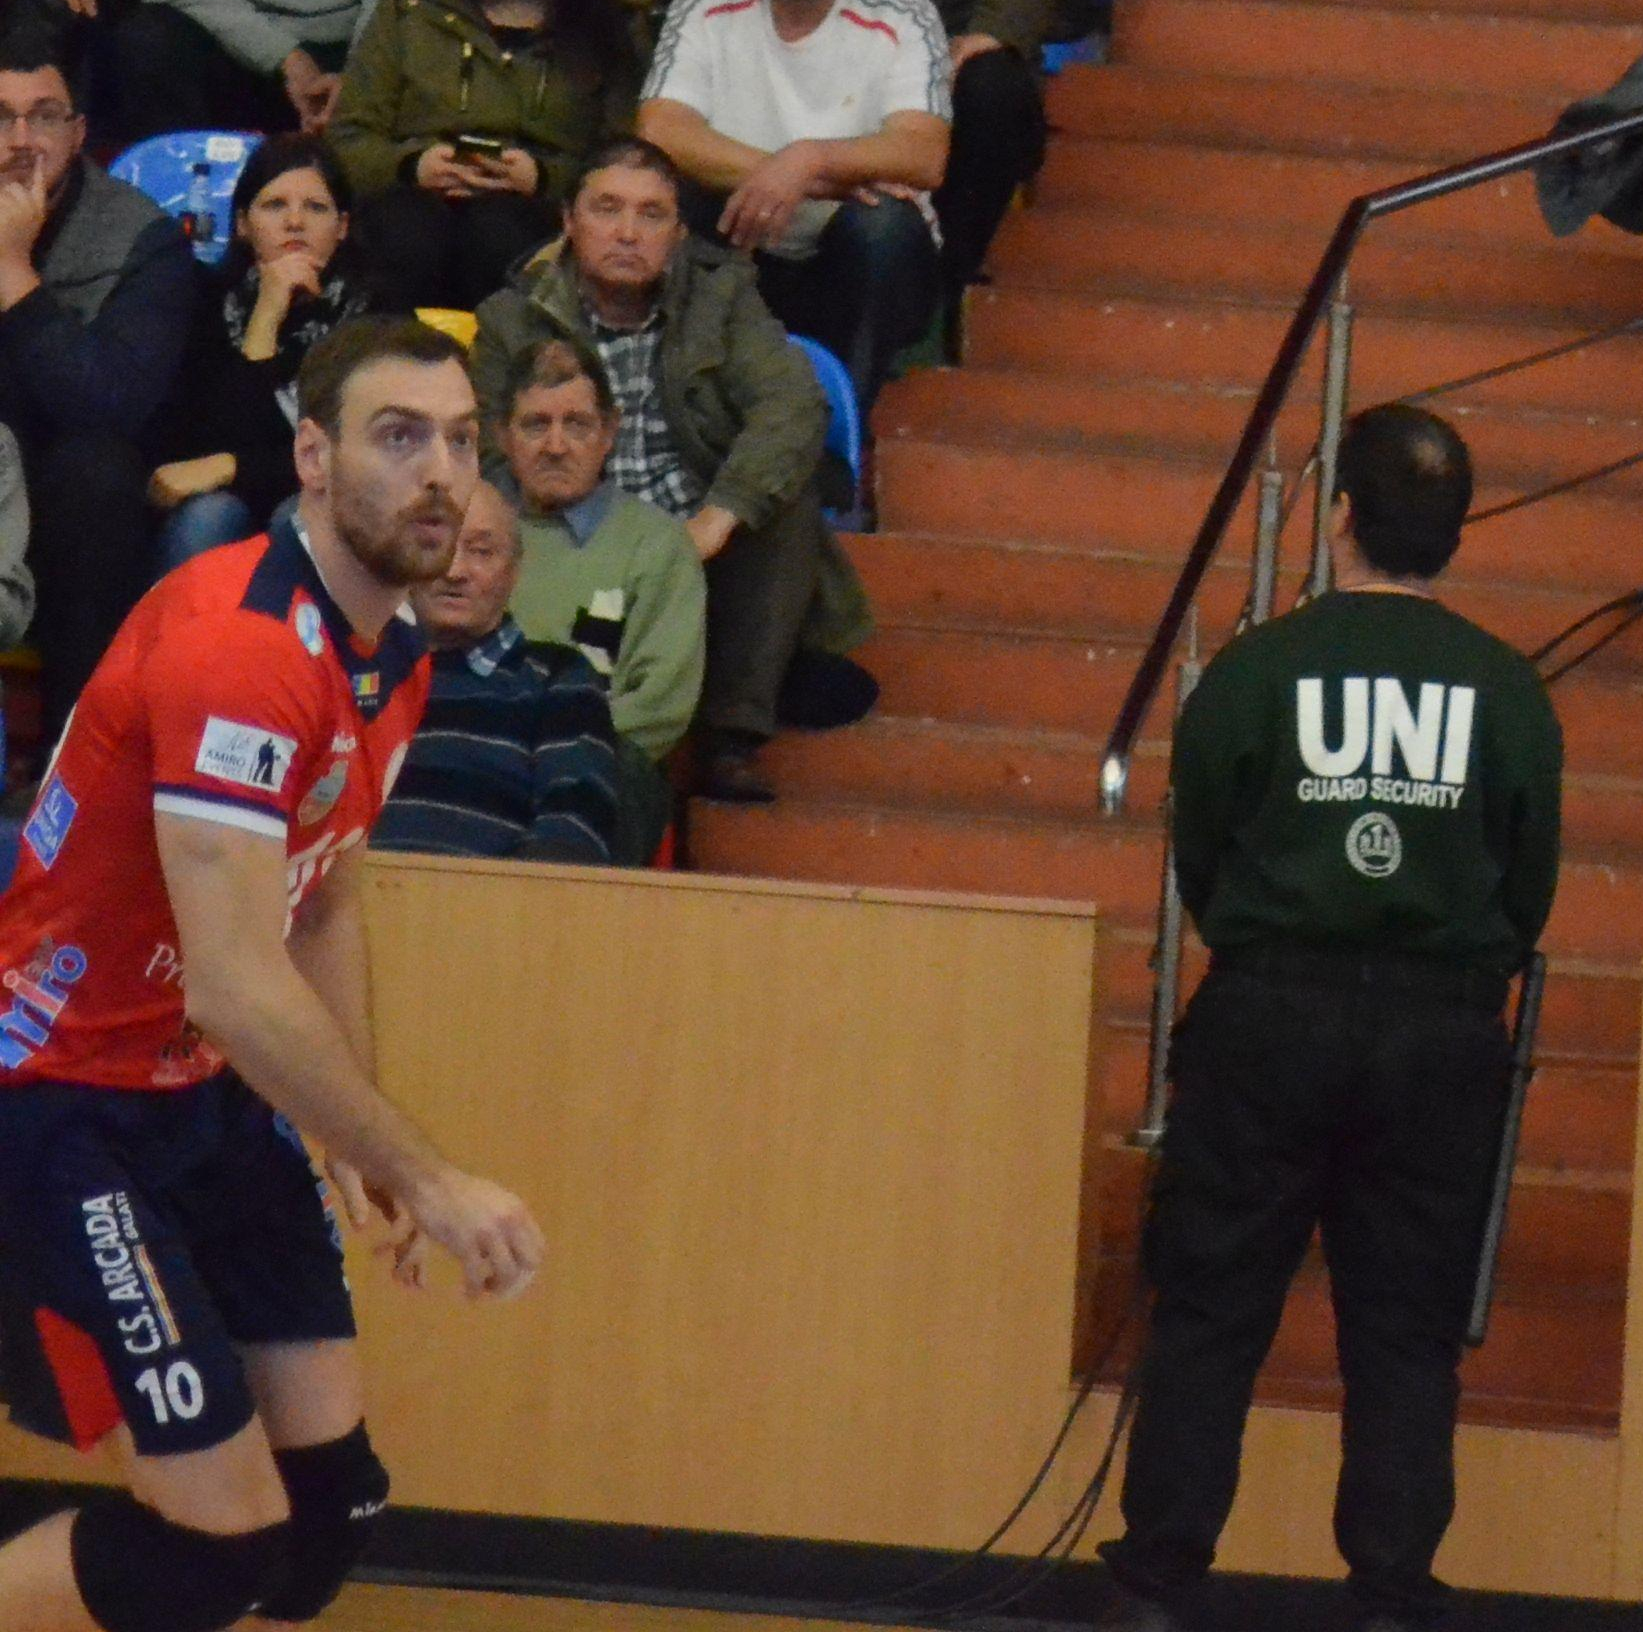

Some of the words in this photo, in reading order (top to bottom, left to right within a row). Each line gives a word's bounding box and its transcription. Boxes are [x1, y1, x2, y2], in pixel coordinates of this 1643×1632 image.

[205, 749, 247, 768] AMIRO
[1297, 677, 1476, 784] UNI
[1297, 777, 1368, 802] GUARD
[1370, 776, 1465, 809] SECURITY
[82, 1192, 145, 1302] ARCADA
[118, 1305, 163, 1355] C.S.
[135, 1361, 204, 1424] 10
